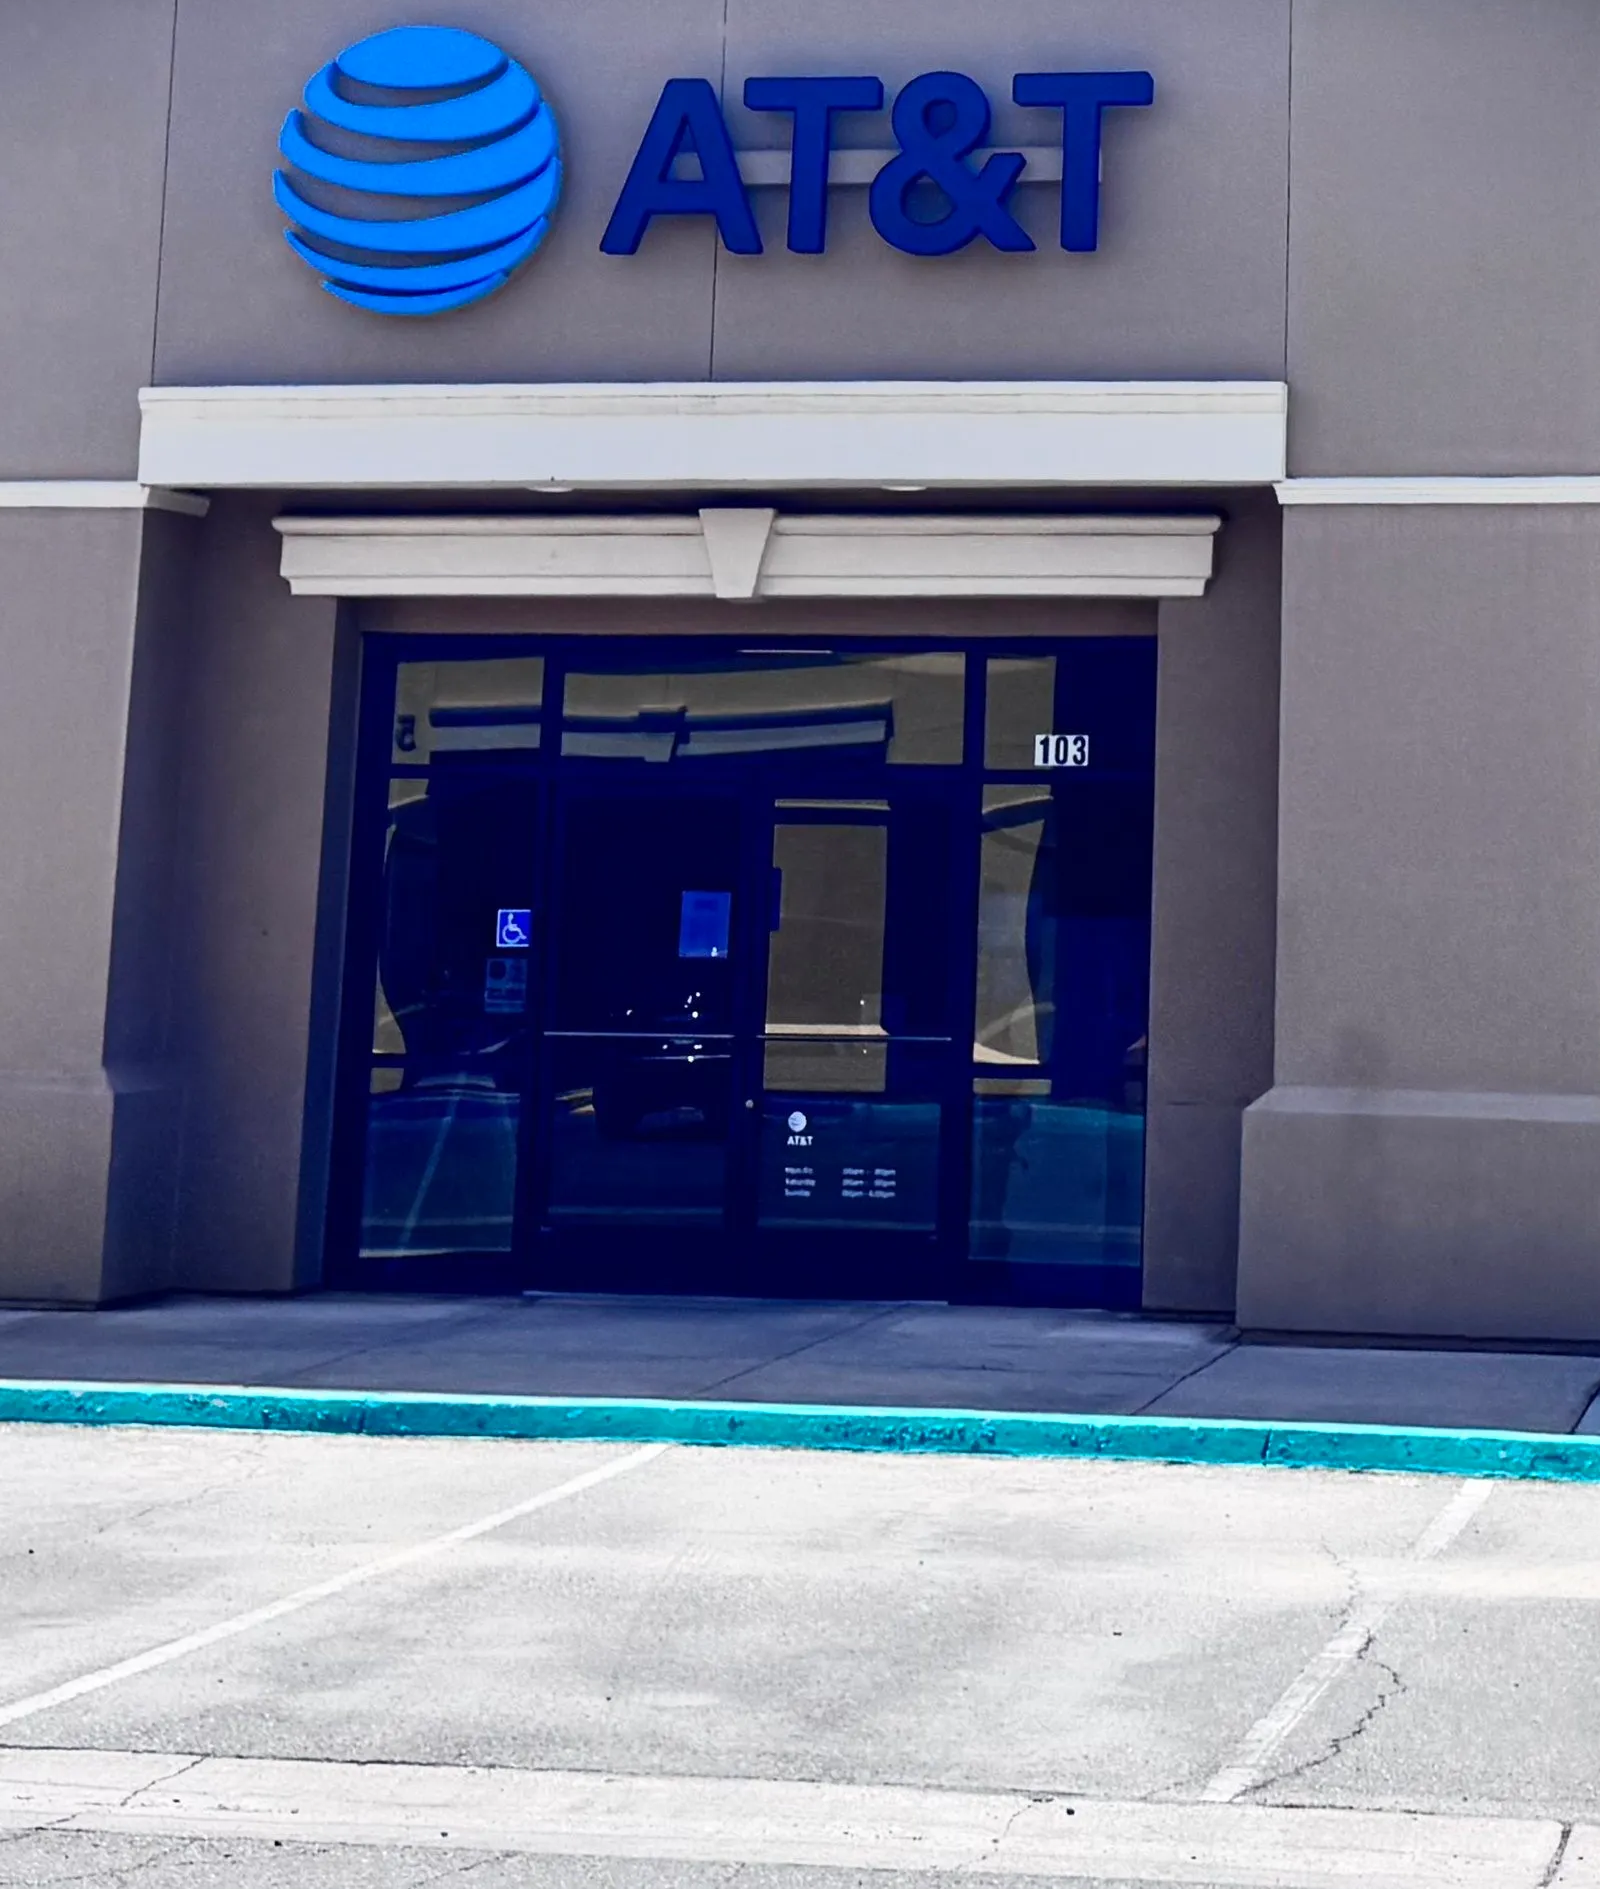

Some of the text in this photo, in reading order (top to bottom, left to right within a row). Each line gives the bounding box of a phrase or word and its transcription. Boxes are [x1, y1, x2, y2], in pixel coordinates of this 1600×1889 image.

[600, 70, 1155, 257] AT&T
[1039, 735, 1087, 766] 103
[787, 1135, 814, 1146] AT&T
